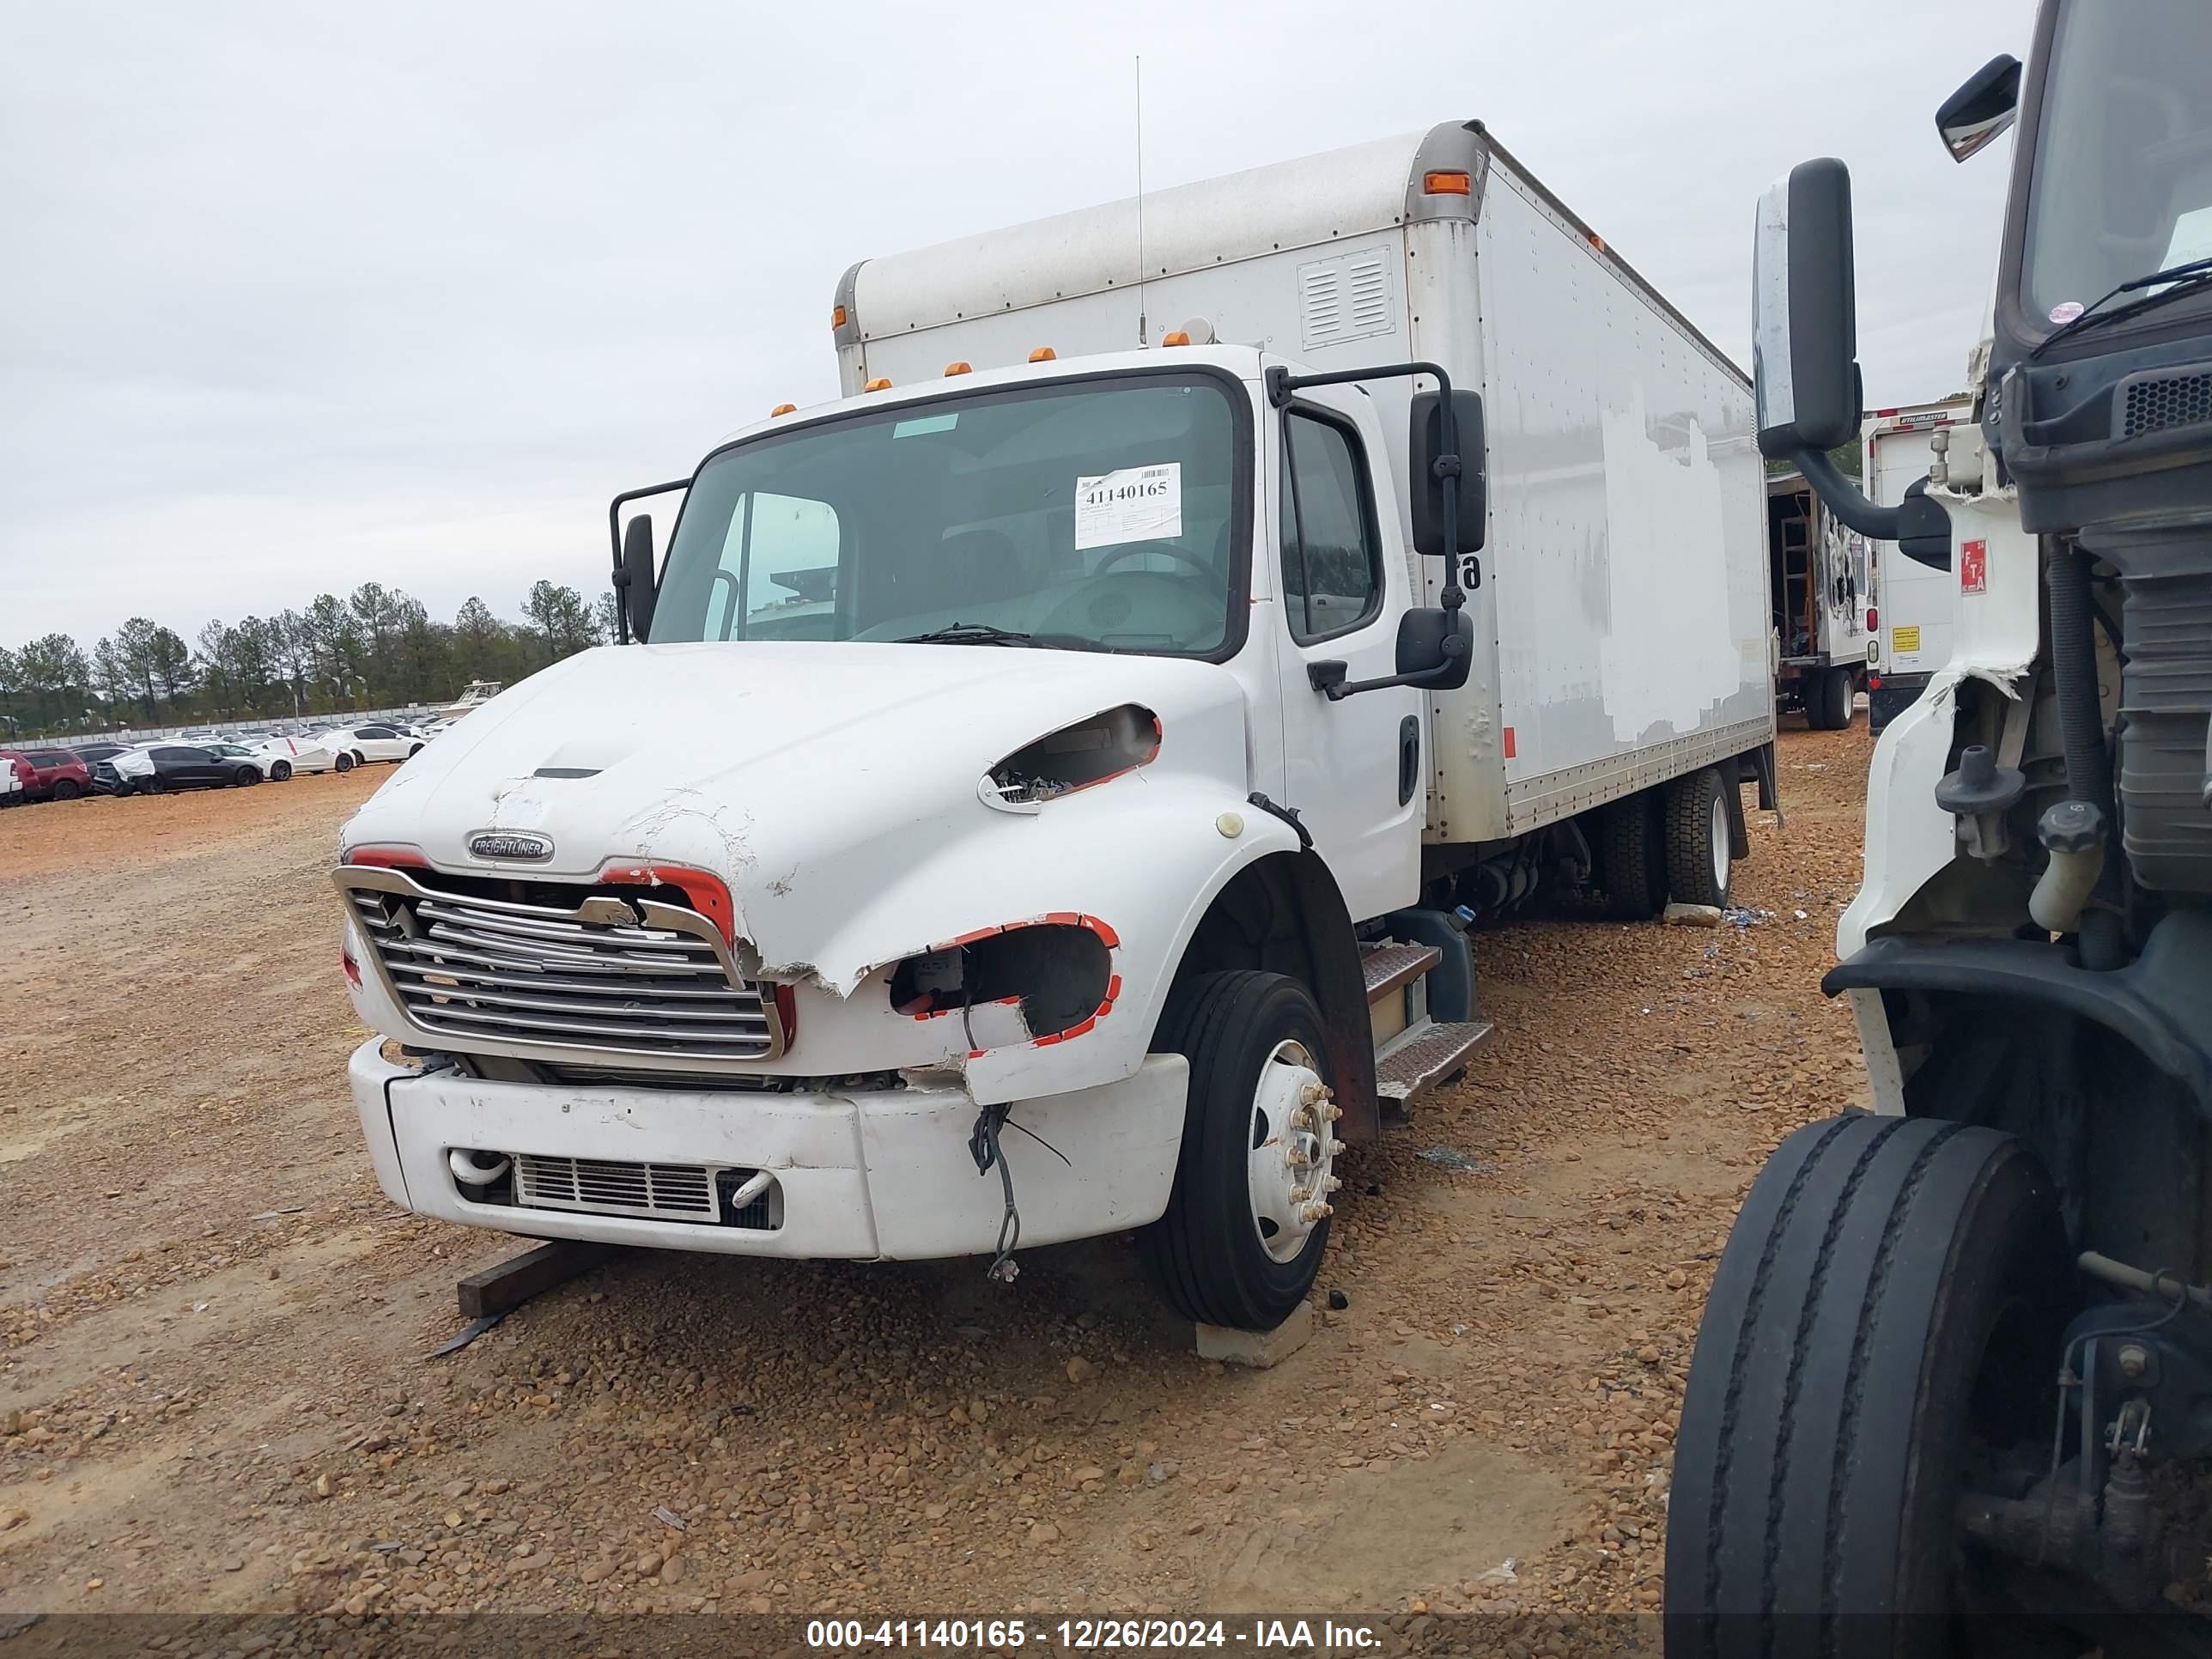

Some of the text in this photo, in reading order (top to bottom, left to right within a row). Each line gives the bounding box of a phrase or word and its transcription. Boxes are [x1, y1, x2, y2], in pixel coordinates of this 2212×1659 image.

[1900, 413, 1947, 424] UTILIMASTER
[1086, 482, 1167, 504] 41140165
[475, 839, 541, 855] FREIGHTLINER
